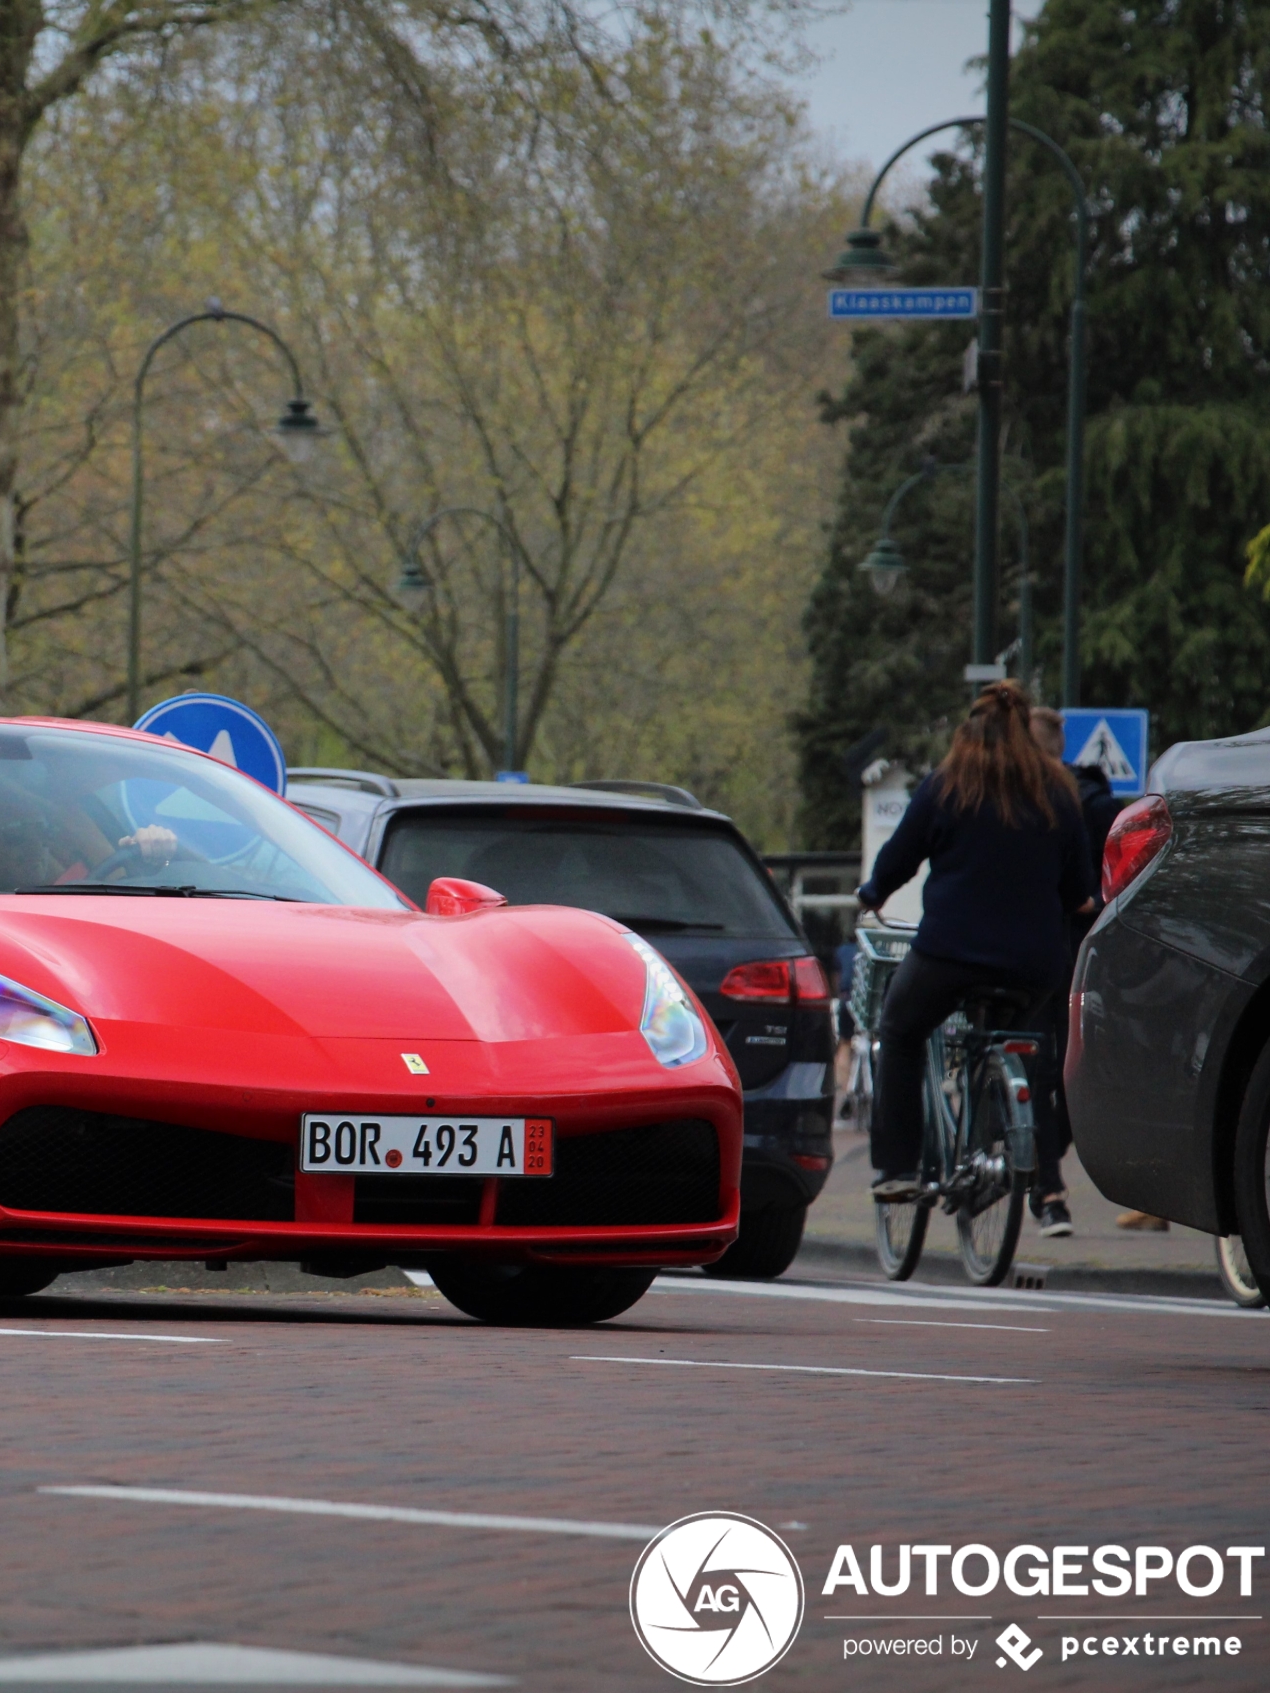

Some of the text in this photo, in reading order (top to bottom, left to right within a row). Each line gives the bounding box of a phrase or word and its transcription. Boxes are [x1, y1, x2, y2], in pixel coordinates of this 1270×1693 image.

[834, 293, 970, 311] Klaaskampen
[528, 1125, 545, 1138] 23
[308, 1121, 517, 1168] BOR 493 A
[528, 1140, 545, 1153] 04
[528, 1155, 545, 1168] 20
